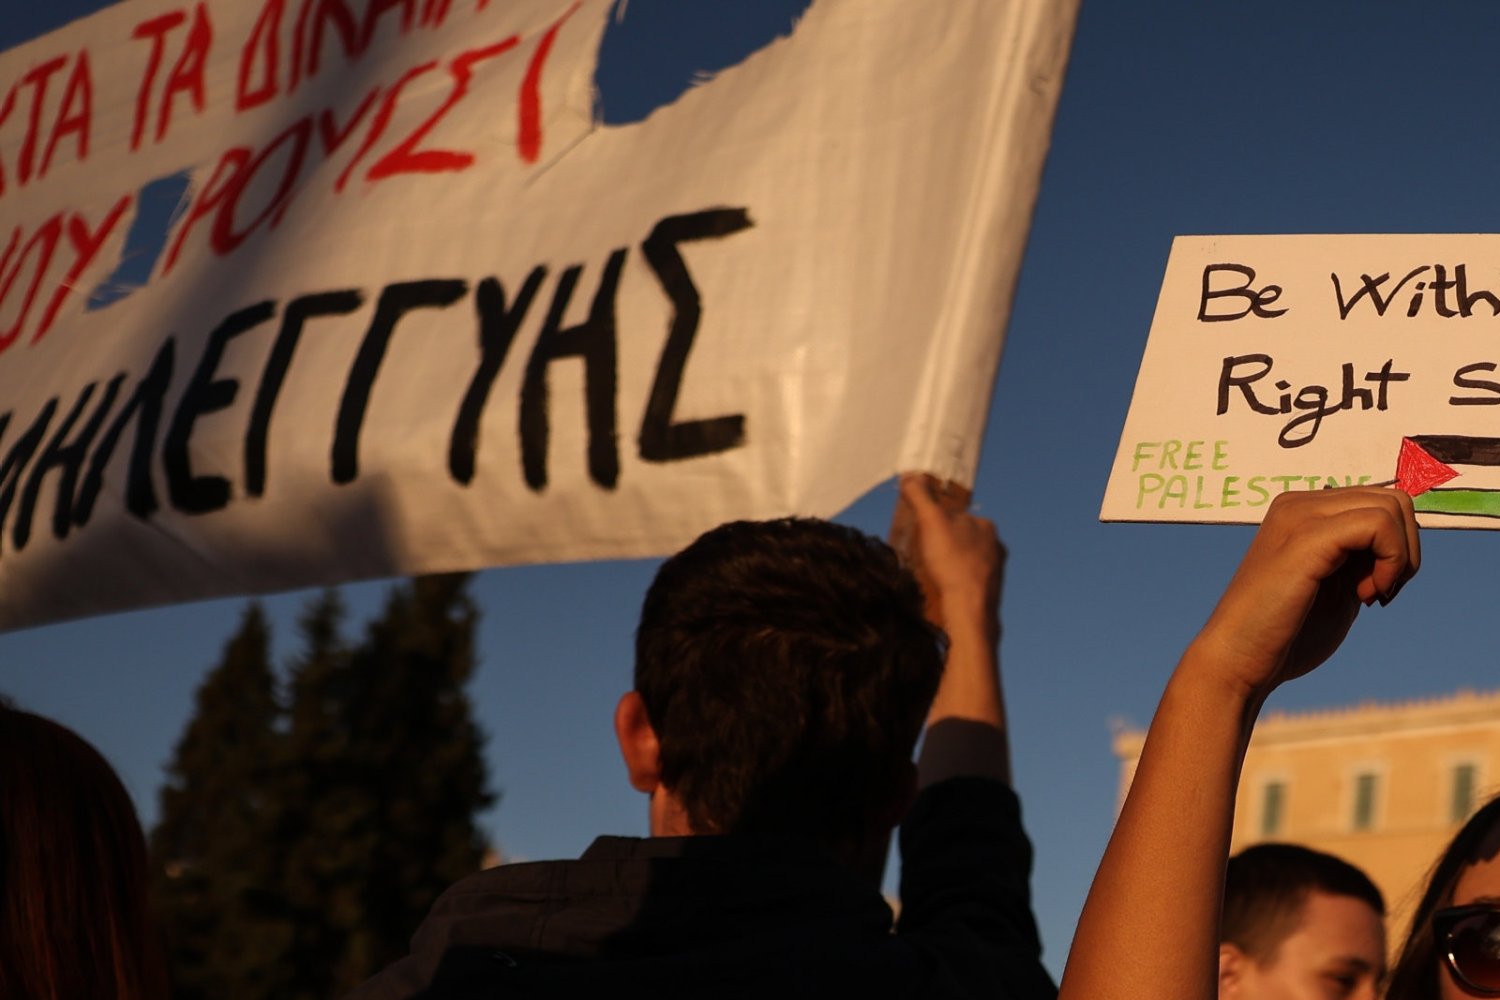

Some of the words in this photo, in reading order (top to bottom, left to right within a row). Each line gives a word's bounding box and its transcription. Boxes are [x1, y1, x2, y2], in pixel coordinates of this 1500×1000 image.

[0, 47, 93, 190] ΤΑ
[131, 0, 213, 152] ΤΑ
[0, 193, 134, 353] ΟΥ
[1197, 262, 1289, 323] Be
[1216, 353, 1410, 448] Right
[1131, 439, 1230, 472] FREE
